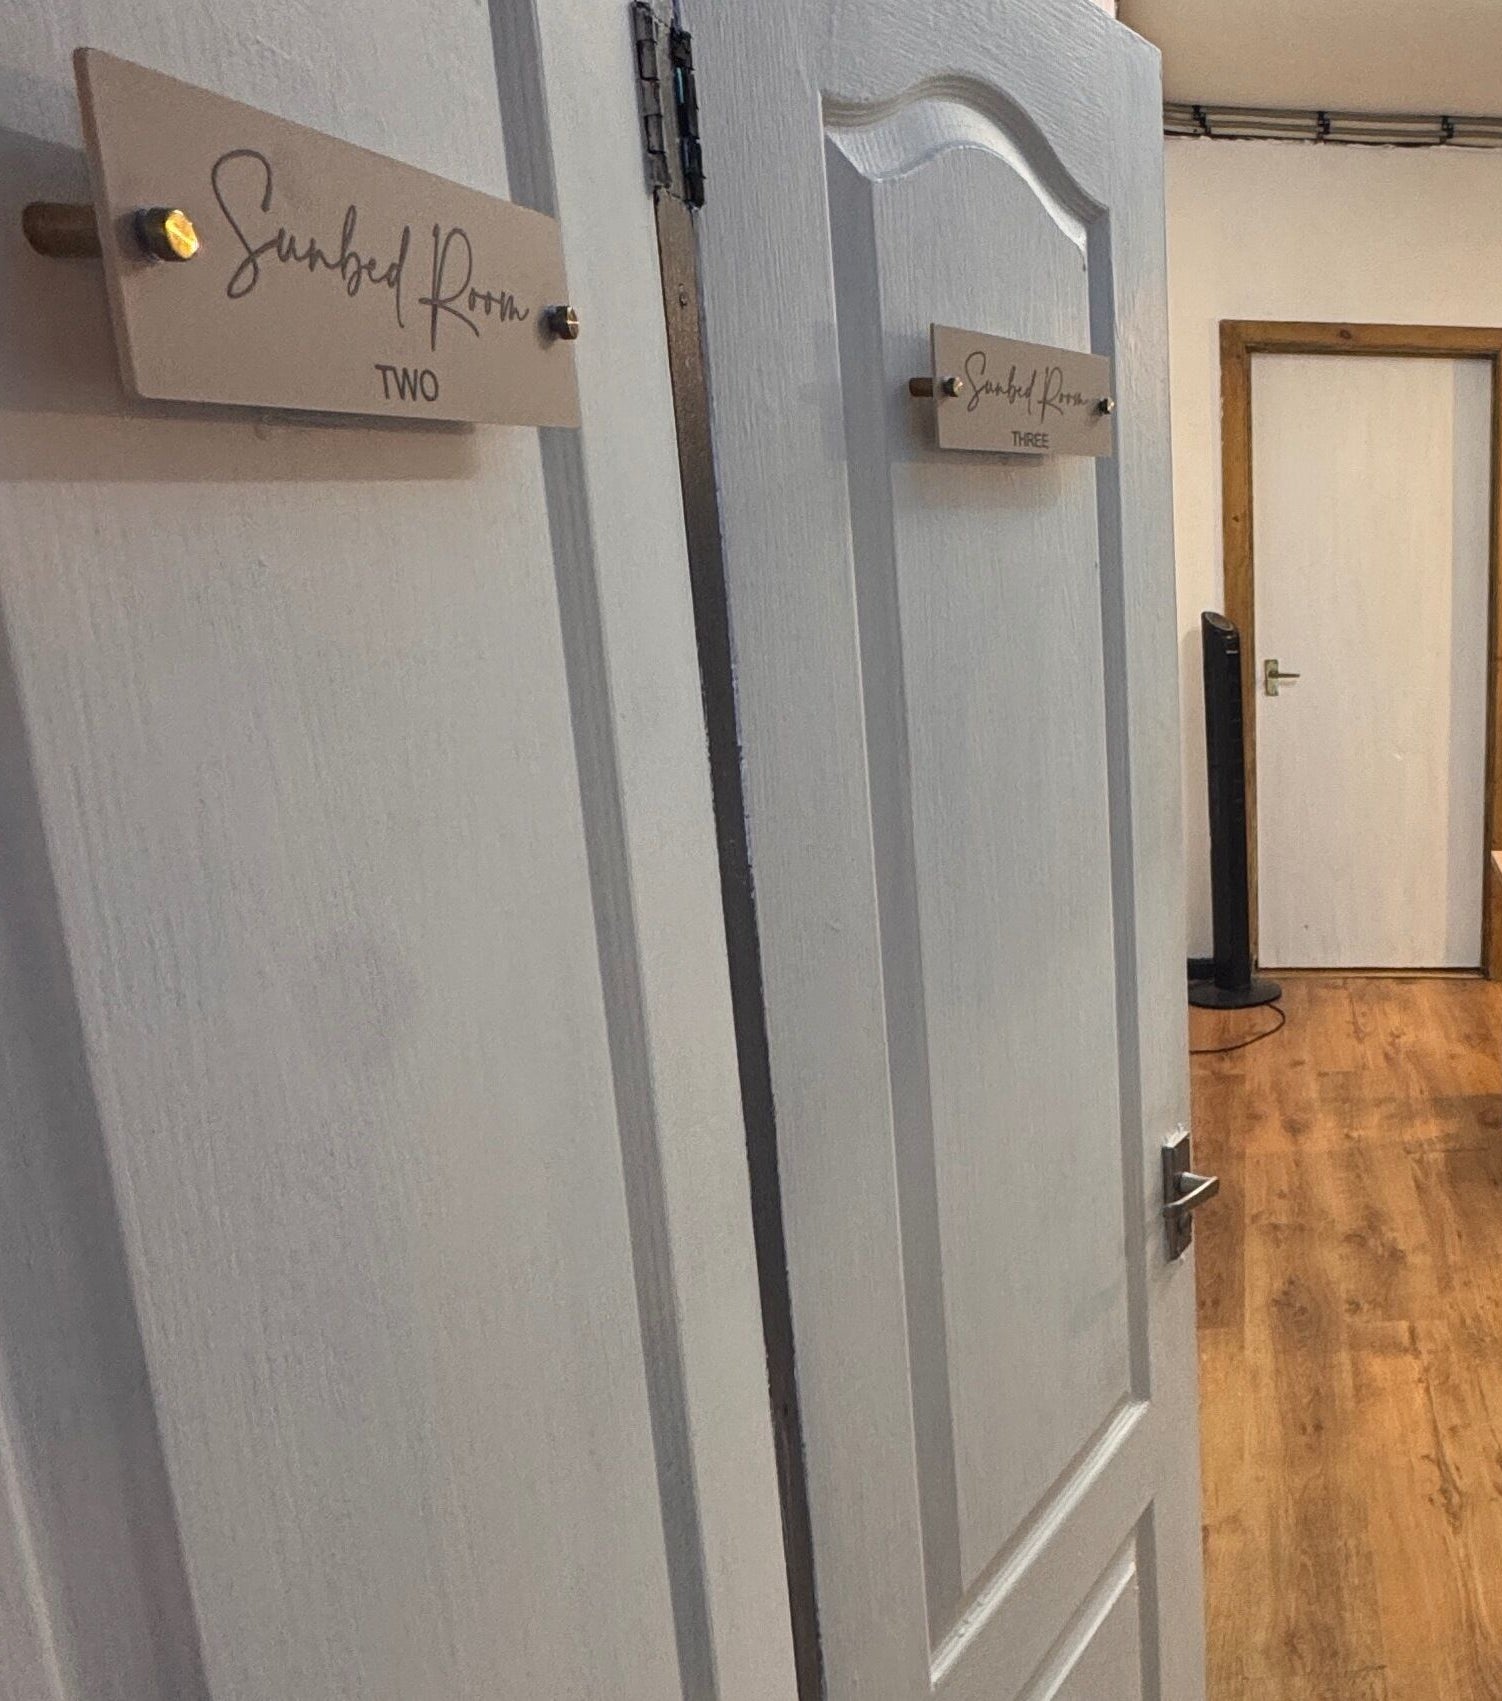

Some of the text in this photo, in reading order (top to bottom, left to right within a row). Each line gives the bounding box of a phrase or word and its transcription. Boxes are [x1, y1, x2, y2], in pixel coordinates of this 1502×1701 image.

[211, 148, 530, 352] Sunbed Room
[374, 363, 439, 403] TWO
[964, 351, 1089, 424] Sunbed Room
[1011, 430, 1050, 449] THREE
